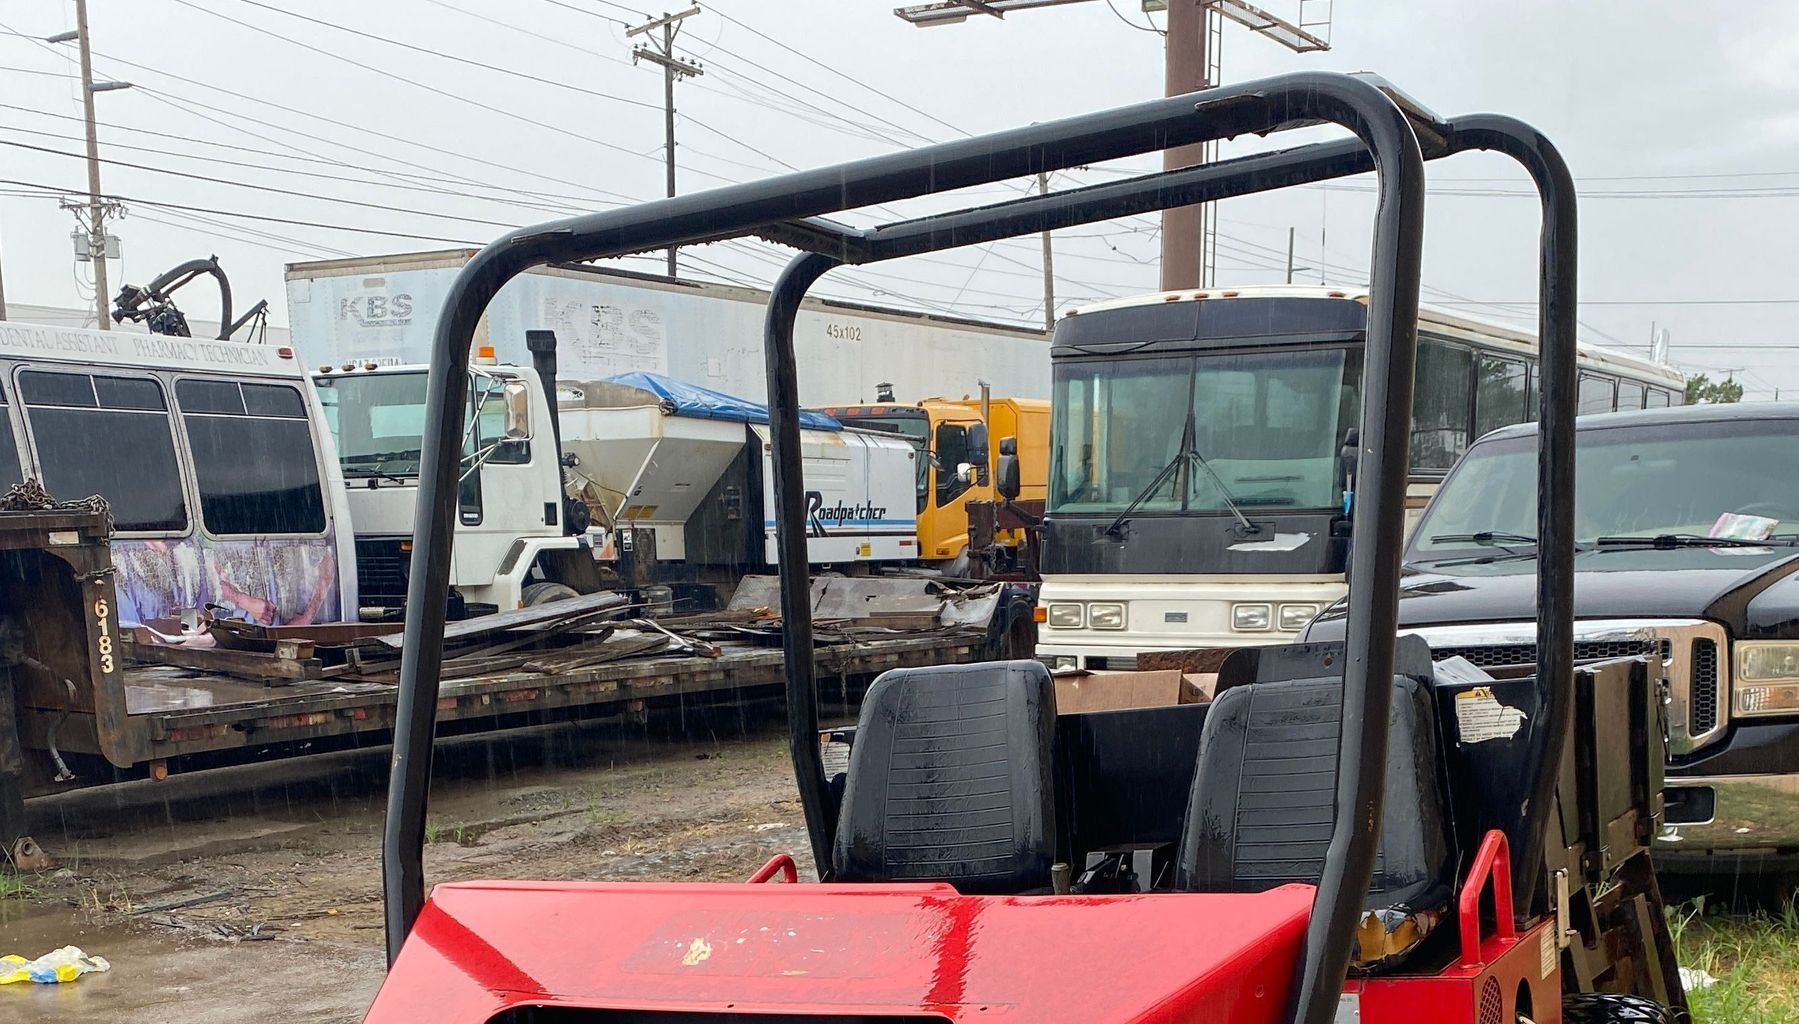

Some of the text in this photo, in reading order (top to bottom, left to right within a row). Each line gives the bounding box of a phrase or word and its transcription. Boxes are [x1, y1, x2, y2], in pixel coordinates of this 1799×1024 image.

[340, 293, 413, 320] KBS
[0, 327, 119, 355] DENTAL ASSISTANT
[826, 323, 862, 341] 45x102
[132, 337, 269, 367] PHARMACY TECHNICIAN
[804, 491, 886, 537] Roadpatcher
[94, 599, 114, 673] 6183
